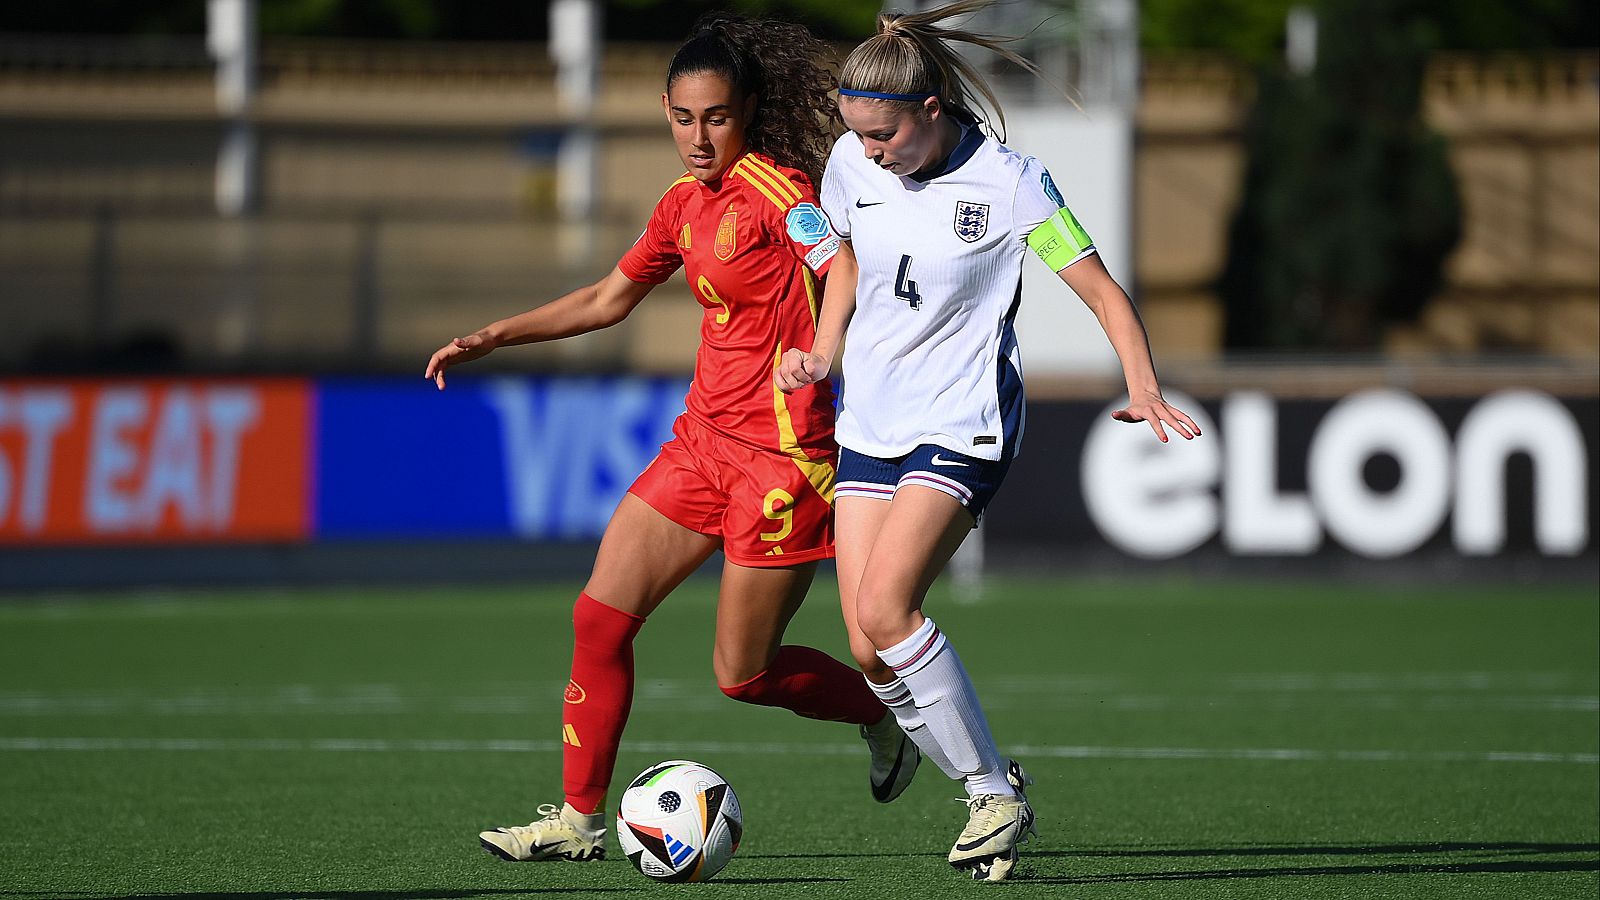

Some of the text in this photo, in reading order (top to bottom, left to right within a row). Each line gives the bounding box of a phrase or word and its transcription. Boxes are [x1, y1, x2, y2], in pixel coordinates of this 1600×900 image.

[697, 274, 730, 325] 9
[894, 254, 922, 312] 4
[84, 385, 260, 533] EAT
[760, 487, 795, 542] 9
